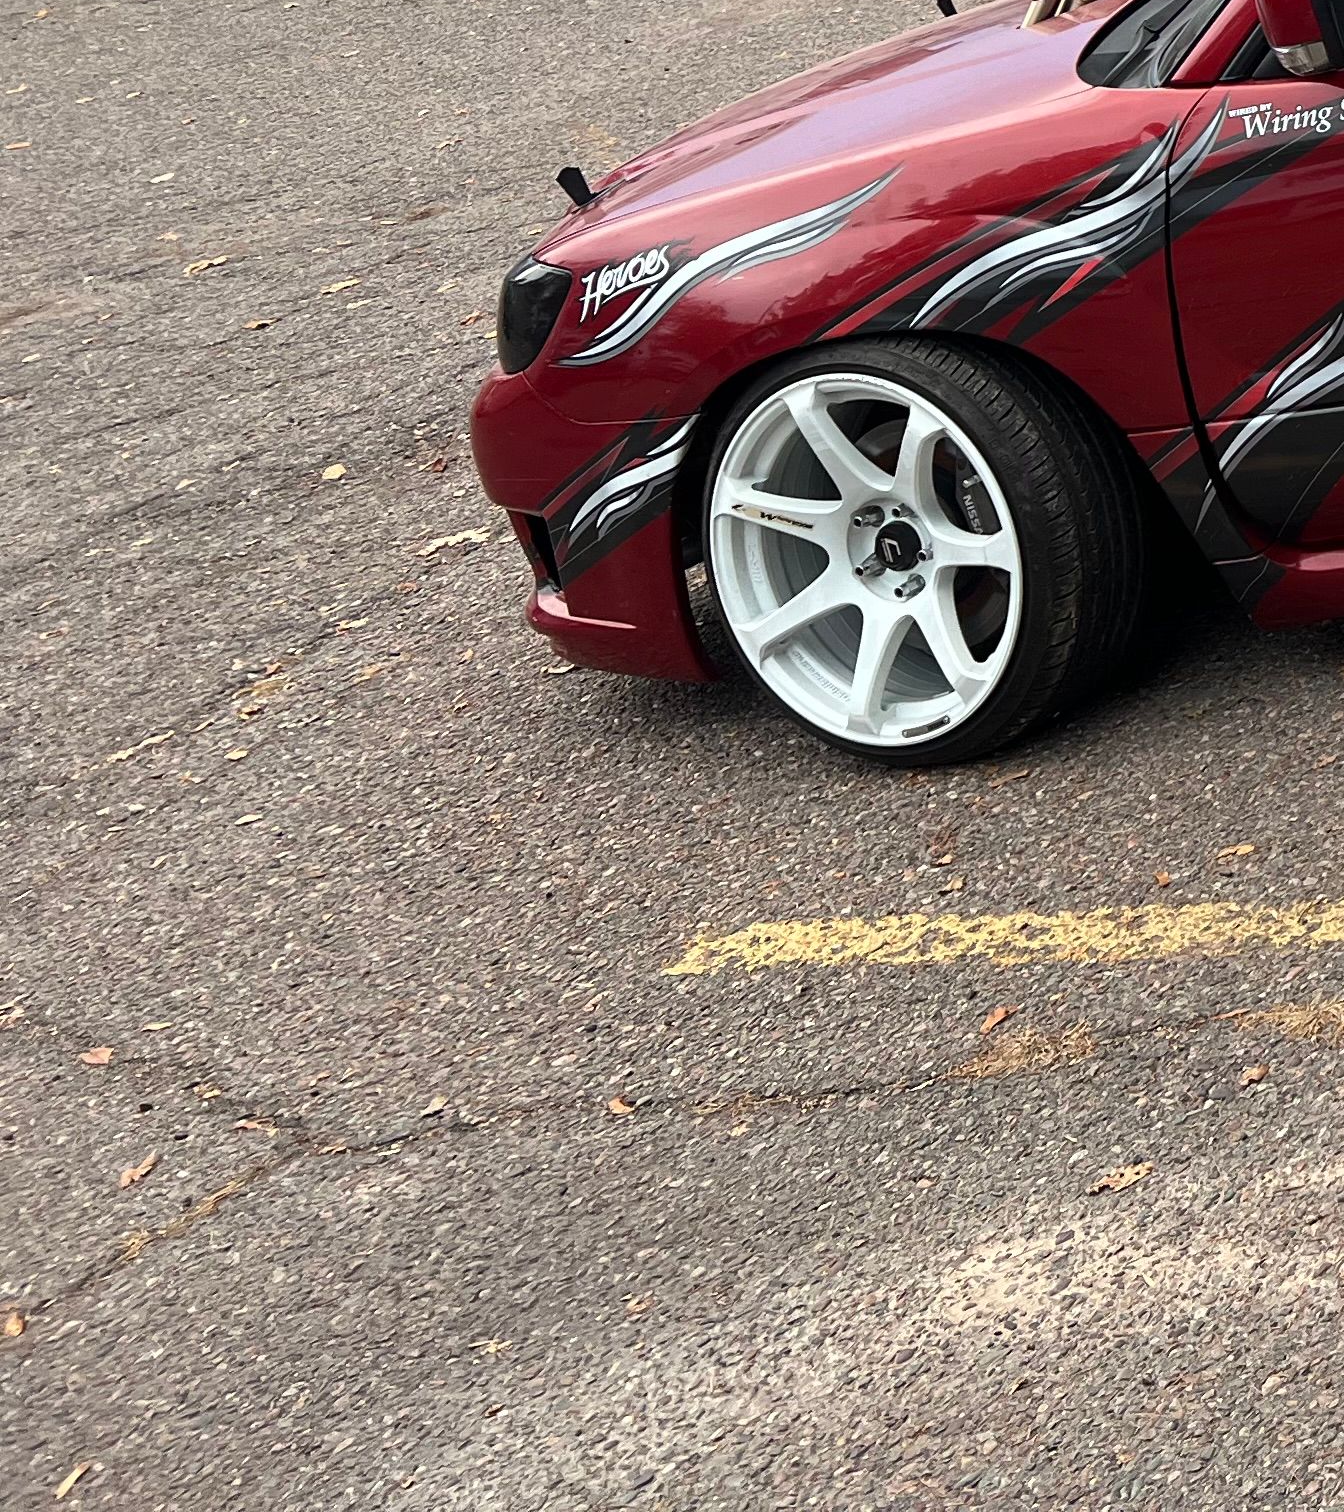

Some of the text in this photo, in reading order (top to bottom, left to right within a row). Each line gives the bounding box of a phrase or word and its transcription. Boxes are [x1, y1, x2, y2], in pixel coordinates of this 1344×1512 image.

[1242, 105, 1334, 139] Wiring
[579, 244, 670, 324] Heroes
[962, 493, 985, 535] NISSA
